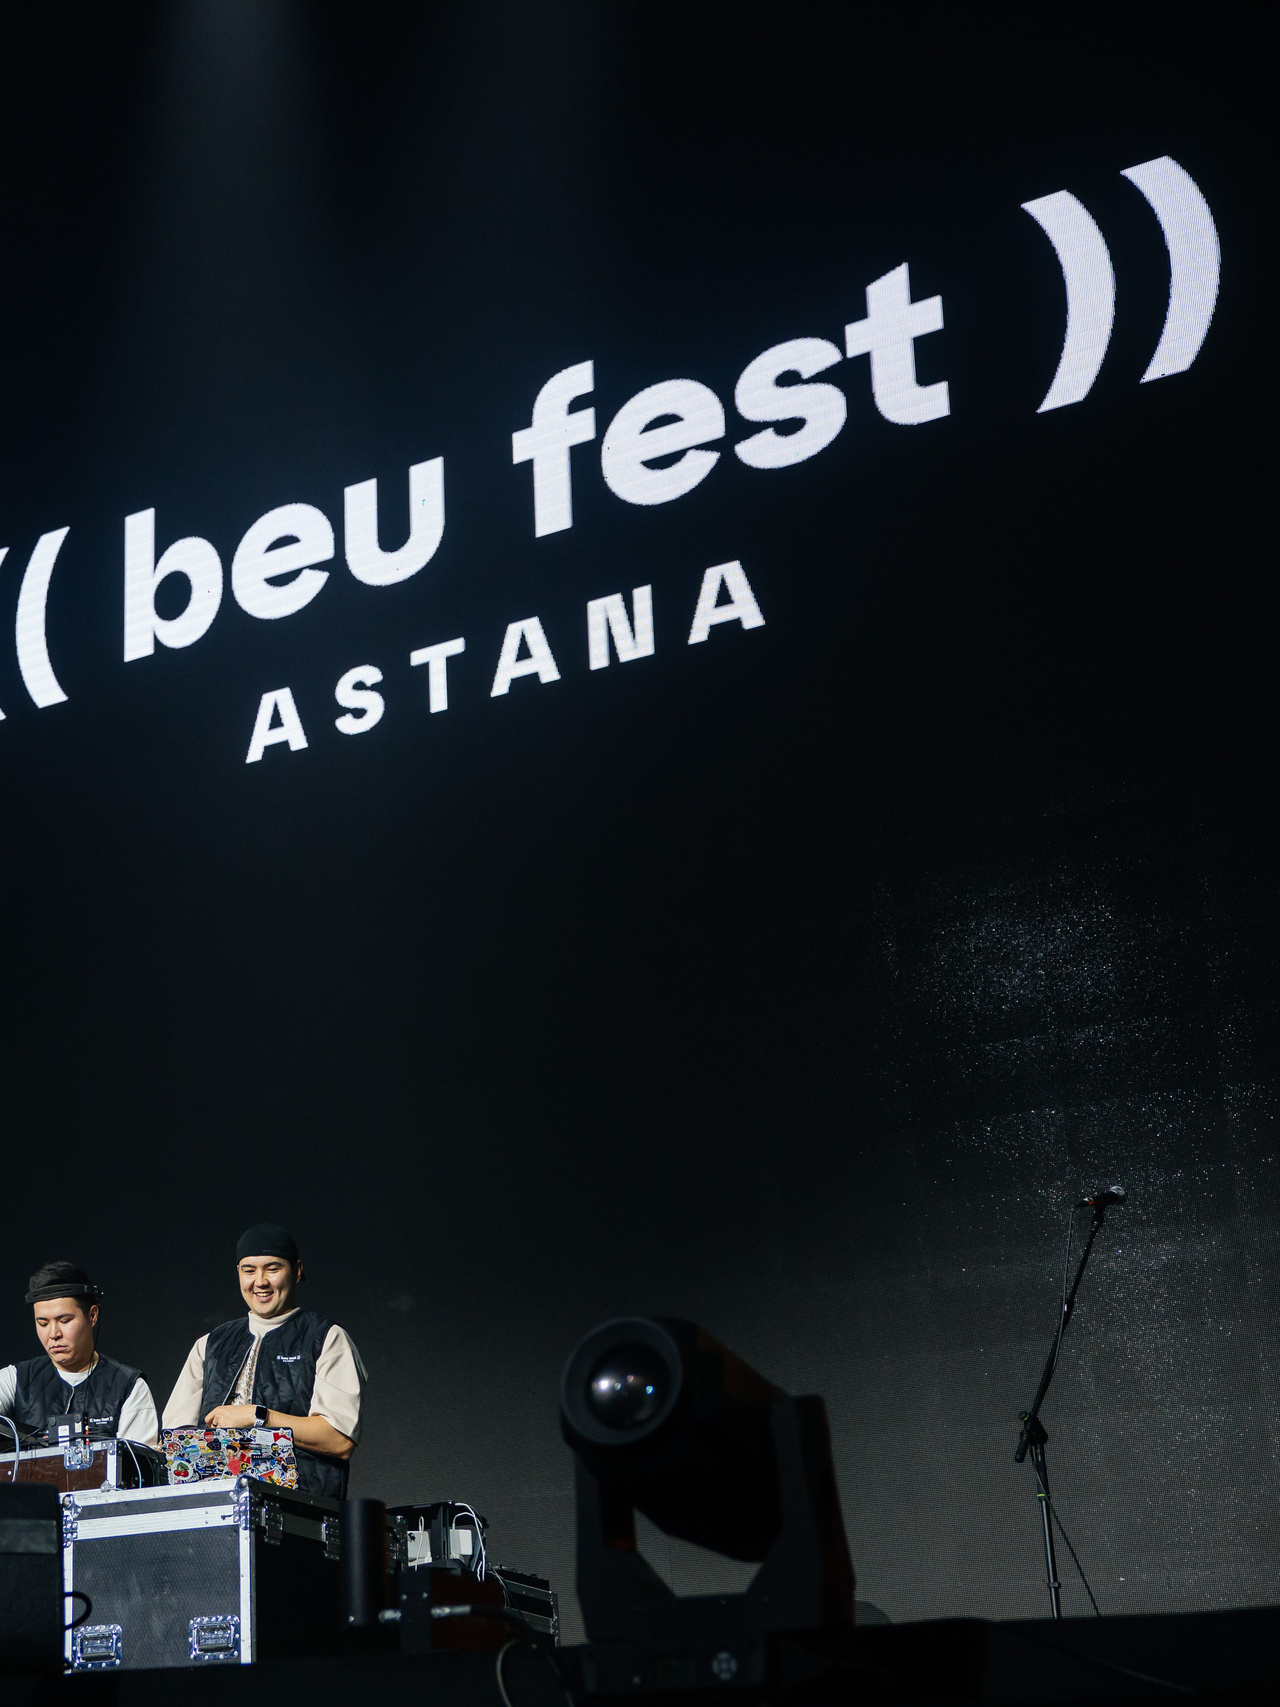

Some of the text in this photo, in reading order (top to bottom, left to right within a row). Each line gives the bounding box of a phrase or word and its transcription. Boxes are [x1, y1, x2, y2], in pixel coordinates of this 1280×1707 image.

[123, 263, 951, 662] beu fest
[245, 560, 766, 764] ASTANA
